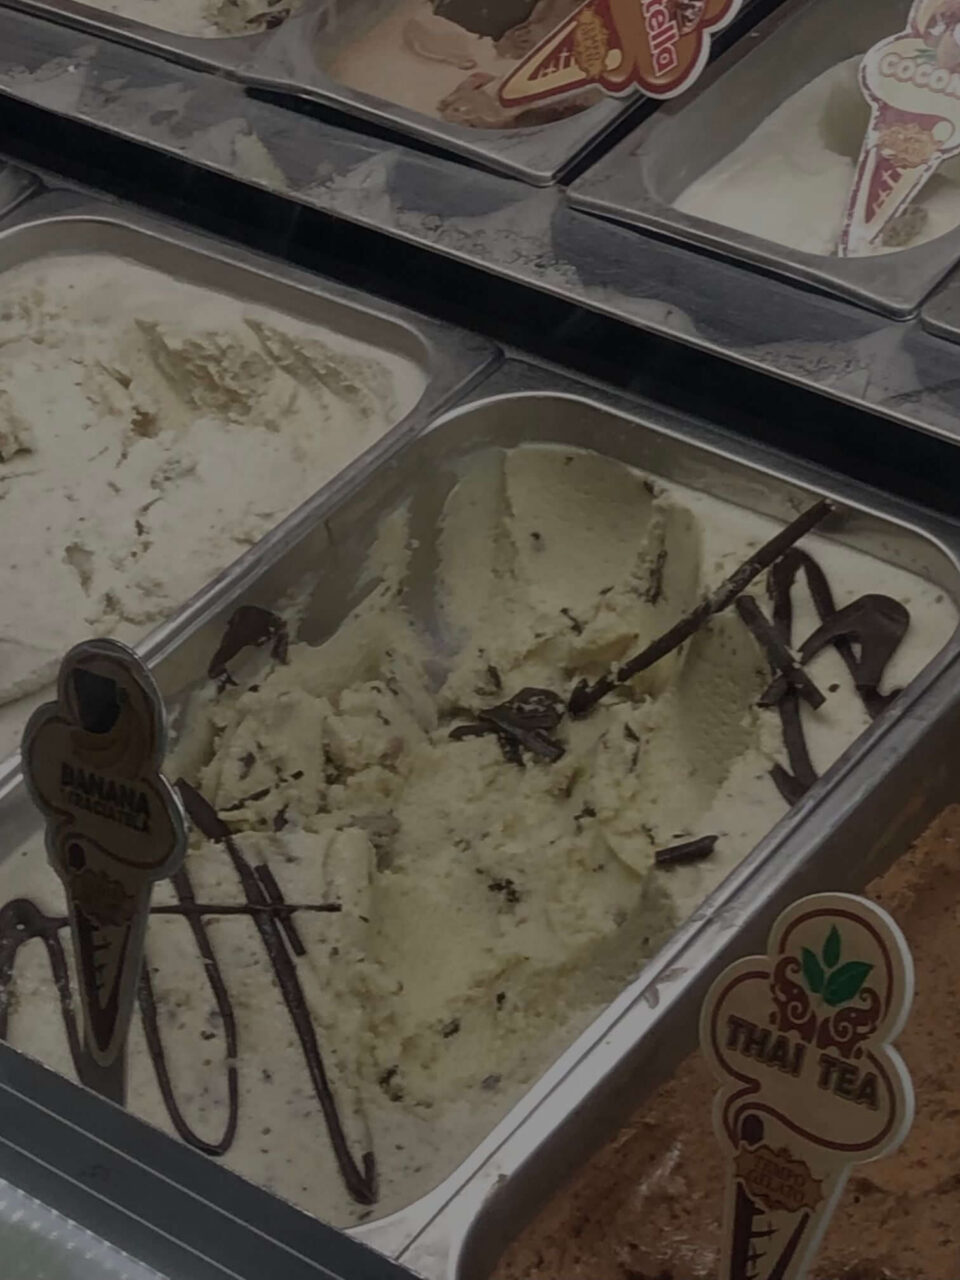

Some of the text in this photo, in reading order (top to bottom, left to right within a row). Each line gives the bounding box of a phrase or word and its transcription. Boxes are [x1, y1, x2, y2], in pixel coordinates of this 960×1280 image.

[60, 762, 150, 814] BANANA
[726, 1014, 880, 1111] THAI TEA
